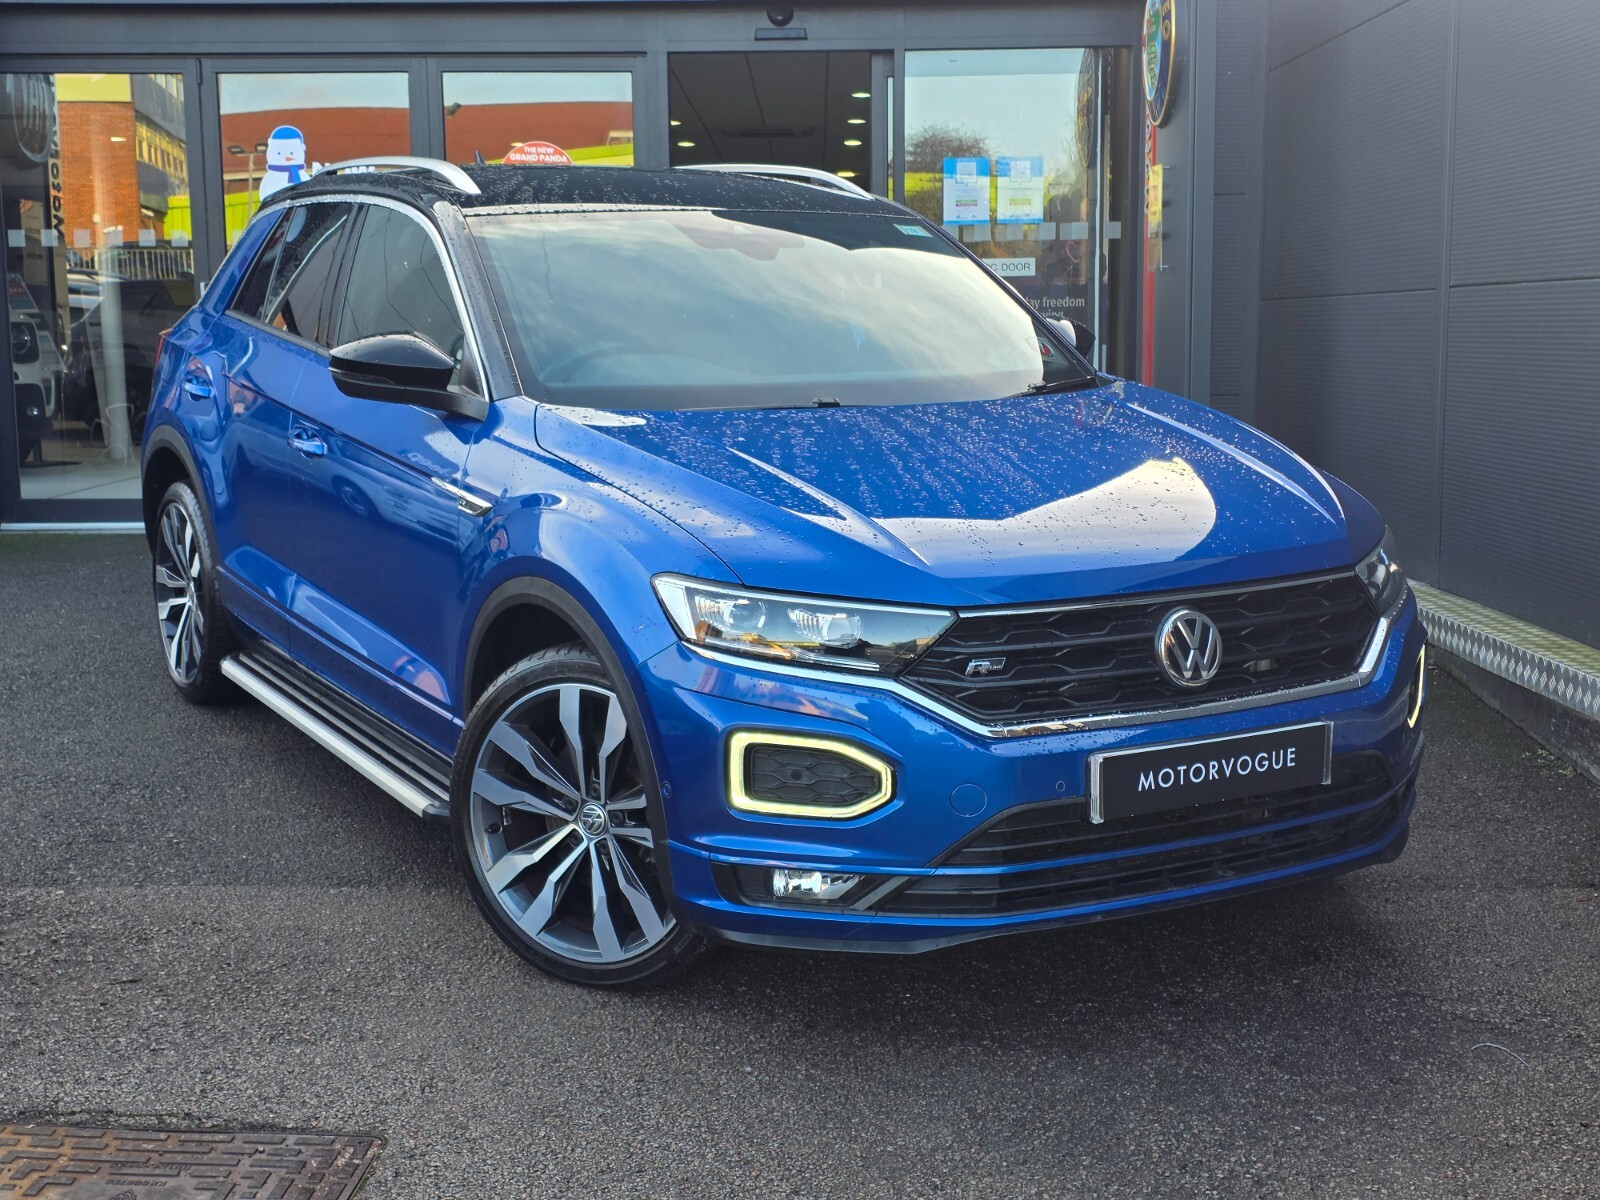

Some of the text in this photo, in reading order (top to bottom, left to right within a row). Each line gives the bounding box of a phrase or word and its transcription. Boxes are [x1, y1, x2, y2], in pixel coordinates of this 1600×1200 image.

[509, 153, 568, 162] GRAND PANDA
[1001, 262, 1031, 272] DOOR
[1042, 296, 1085, 308] freedom
[1137, 747, 1296, 792] MOTORVOGUE
